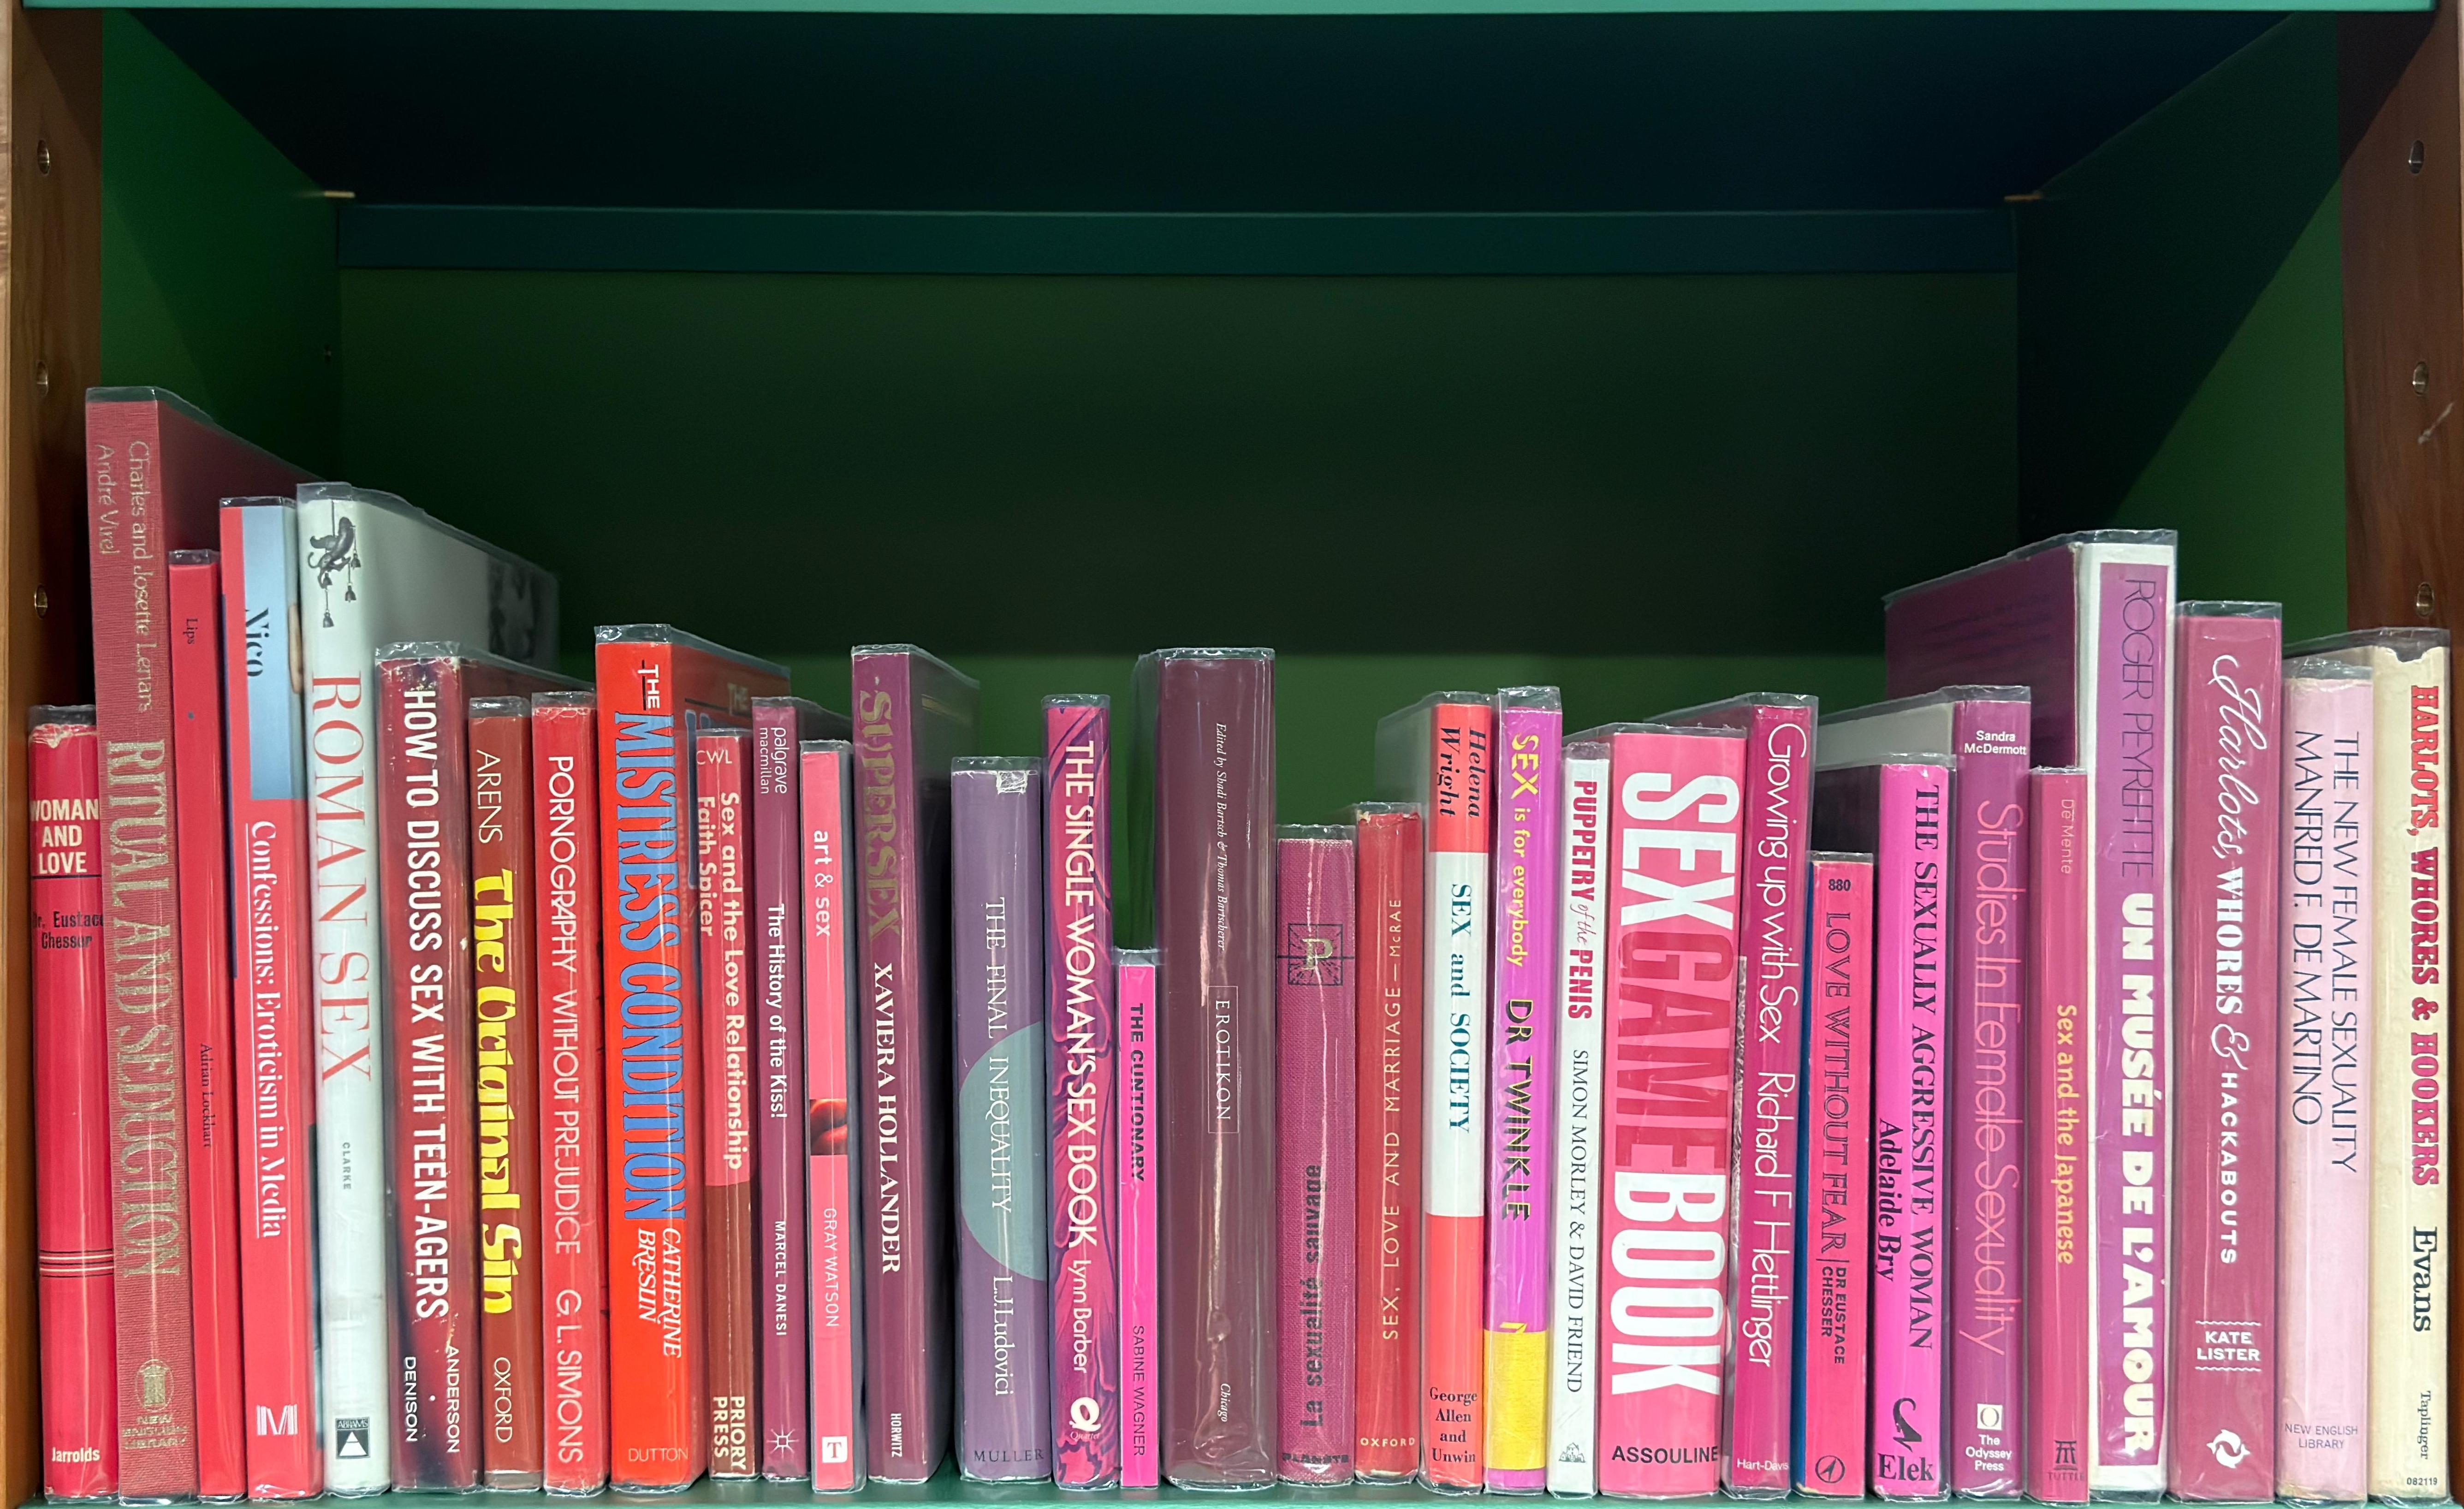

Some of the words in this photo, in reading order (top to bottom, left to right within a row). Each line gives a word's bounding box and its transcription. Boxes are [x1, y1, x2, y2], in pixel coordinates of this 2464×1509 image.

[95, 445, 116, 505] André
[129, 440, 151, 516] Charles
[186, 618, 198, 645] Lips
[2121, 580, 2156, 701] ROGER
[404, 691, 437, 760] HOW
[759, 727, 770, 794] macmillan
[771, 727, 790, 794] palgrave
[1216, 723, 1226, 754] Edited
[1964, 743, 2027, 755] McDermott
[1976, 731, 2016, 742] Sandra
[2333, 731, 2359, 789] THE
[2406, 685, 2439, 836] HARLOTS,
[312, 671, 368, 926] ROMAN
[476, 749, 503, 844] ARENS
[1066, 741, 1094, 796] THE
[1217, 771, 1226, 800] Shadi
[1437, 727, 1461, 817] Wright
[1468, 727, 1486, 819] Helena
[1512, 734, 1539, 799] SEX
[1757, 723, 1806, 858] Growing
[30, 799, 98, 821] WOMAN
[42, 825, 83, 847] AND
[106, 740, 169, 907] RITUAL
[614, 712, 682, 952] MISTRESS
[721, 792, 740, 837] Sex
[1217, 802, 1226, 838] Bartsch
[1571, 781, 1597, 901] PUPPETRY
[1916, 785, 1939, 851] THE
[2293, 731, 2323, 885] MANFRED
[2333, 802, 2359, 877] NEW
[39, 852, 87, 874] LOVE
[549, 756, 577, 973] PORNOGRAPHY
[813, 830, 833, 865] art
[1065, 805, 1094, 907] SINGLE
[1217, 854, 1227, 893] Thomas
[1828, 879, 1851, 891] 880
[1976, 800, 2026, 945] Studies
[2060, 826, 2074, 874] Mente
[251, 821, 278, 985] Confessions:
[407, 821, 442, 951] DISCUSS
[474, 868, 513, 973] The
[815, 897, 830, 937] sex
[1217, 895, 1227, 951] Bartscherer
[1451, 884, 1471, 937] SEX
[1507, 866, 1529, 967] everybody
[2411, 847, 2439, 985] WHORES
[1389, 900, 1401, 956] McRAE
[1825, 912, 1851, 998] LOVE
[1913, 861, 1938, 1015] SEXUALLY
[2215, 867, 2243, 1014] WHORES
[2332, 885, 2357, 1001] FEMALE
[114, 918, 173, 1014] AND
[410, 964, 444, 1023] SEX
[724, 949, 743, 1007] Love
[766, 944, 785, 1009] History
[986, 964, 1008, 1039] FINAL
[1066, 914, 1096, 1075] WOMAN'S
[1568, 949, 1593, 1019] PENIS
[319, 951, 371, 1081] SEX
[552, 989, 579, 1103] WITHOUT
[875, 962, 896, 1088] XAVIERA
[1130, 1003, 1143, 1042] THE
[1384, 987, 1401, 1111] MARRIAGE
[1758, 985, 1799, 1044] Sex
[2057, 1005, 2077, 1046] Sex
[200, 1044, 214, 1086] Adrian
[256, 992, 283, 1120] Eroticism
[411, 1034, 445, 1112] WITH
[619, 962, 686, 1220] CONDITION
[723, 1014, 748, 1170] Relationship
[1216, 1000, 1230, 1120] EROTIKON
[1449, 1013, 1471, 1132] SOCIETY
[1573, 1050, 1589, 1120] SIMON
[1823, 1006, 1850, 1166] WITHOUT
[1975, 1002, 2023, 1153] Female
[2122, 975, 2162, 1136] MUSÉE
[2331, 1011, 2357, 1173] SEXUALITY
[201, 1091, 214, 1147] Lockhart
[477, 986, 521, 1210] Original
[770, 1075, 788, 1118] Kiss!
[1068, 1081, 1096, 1137] SEX
[1130, 1050, 1144, 1182] CUNTIONARY
[1755, 1071, 1795, 1178] Richard
[1911, 1024, 1936, 1215] AGGRESSIVE
[2411, 1032, 2439, 1186] HOOKERS
[117, 1025, 180, 1277] SEDUCTION
[343, 1142, 351, 1190] CLARKE
[986, 1057, 1012, 1213] INEQUALITY
[1504, 1055, 1532, 1221] TWINKLE
[1570, 1124, 1586, 1215] MORLEY
[1878, 1118, 1903, 1226] Adelaide
[2221, 1072, 2238, 1264] HACKABOUTS
[261, 1156, 287, 1237] Media
[554, 1111, 580, 1254] PREJUDICE
[878, 1095, 900, 1274] HOLLANDER
[1068, 1145, 1097, 1247] BOOK
[1821, 1172, 1848, 1254] FEAR
[2050, 1154, 2077, 1265] Japanese
[413, 1123, 449, 1318] TEEN-AGERS
[775, 1221, 786, 1278] MARCEL
[823, 1208, 837, 1251] GRAY
[1384, 1206, 1400, 1267] LOVE
[1876, 1234, 1901, 1282] Bry
[1959, 1161, 2021, 1355] Sexuality
[482, 1222, 522, 1313] Sin
[632, 1229, 657, 1324] BRESLIN
[658, 1228, 682, 1359] CATHERINE
[824, 1255, 839, 1327] WATSON
[1068, 1259, 1091, 1303] Lynn
[1569, 1245, 1585, 1310] DAVID
[1742, 1221, 1791, 1367] Hettlinger
[1821, 1266, 1833, 1337] CHESSER
[1909, 1225, 1934, 1349] WOMAN
[2412, 1226, 2437, 1332] Evans
[775, 1284, 786, 1336] DANESI
[1073, 1308, 1092, 1373] Barber
[1300, 1277, 1323, 1387] sexualité
[1834, 1293, 1847, 1365] EUSTACE
[2122, 1227, 2154, 1456] L'AMOUR
[2205, 1331, 2252, 1344] KATE
[1133, 1325, 1145, 1382] SABINE
[1567, 1315, 1583, 1393] FRIEND
[2197, 1348, 2260, 1362] LISTER
[337, 1419, 368, 1428] ABRAMS
[404, 1357, 417, 1442] DENISON
[445, 1347, 460, 1453] ANDERSON
[494, 1357, 513, 1443] OXFORD
[557, 1350, 583, 1463] SIMONS
[713, 1397, 729, 1457] PRESS
[1134, 1387, 1145, 1456] WAGNER
[1217, 1384, 1231, 1422] Chicago
[1430, 1387, 1478, 1402] George
[1436, 1410, 1471, 1422] Allen
[2285, 1423, 2311, 1436] NEW
[2315, 1425, 2357, 1436] ENGLISH
[2417, 1390, 2431, 1460] Taplinger
[52, 1447, 100, 1463] Jarrolds
[628, 1448, 688, 1461] DUTTON
[730, 1396, 746, 1471] PRIORY
[891, 1413, 902, 1457] HORWITZ
[974, 1449, 1045, 1462] MULLER
[1360, 1437, 1415, 1447] OXFORD
[1432, 1448, 1476, 1463] Unwin
[1612, 1446, 1718, 1464] ASSOULINE
[1877, 1453, 1934, 1482] Elek
[1965, 1447, 2012, 1461] Odyssey
[1974, 1461, 2004, 1471] Press
[2298, 1438, 2345, 1449] LIBRARY
[2406, 1477, 2437, 1486] 082119
